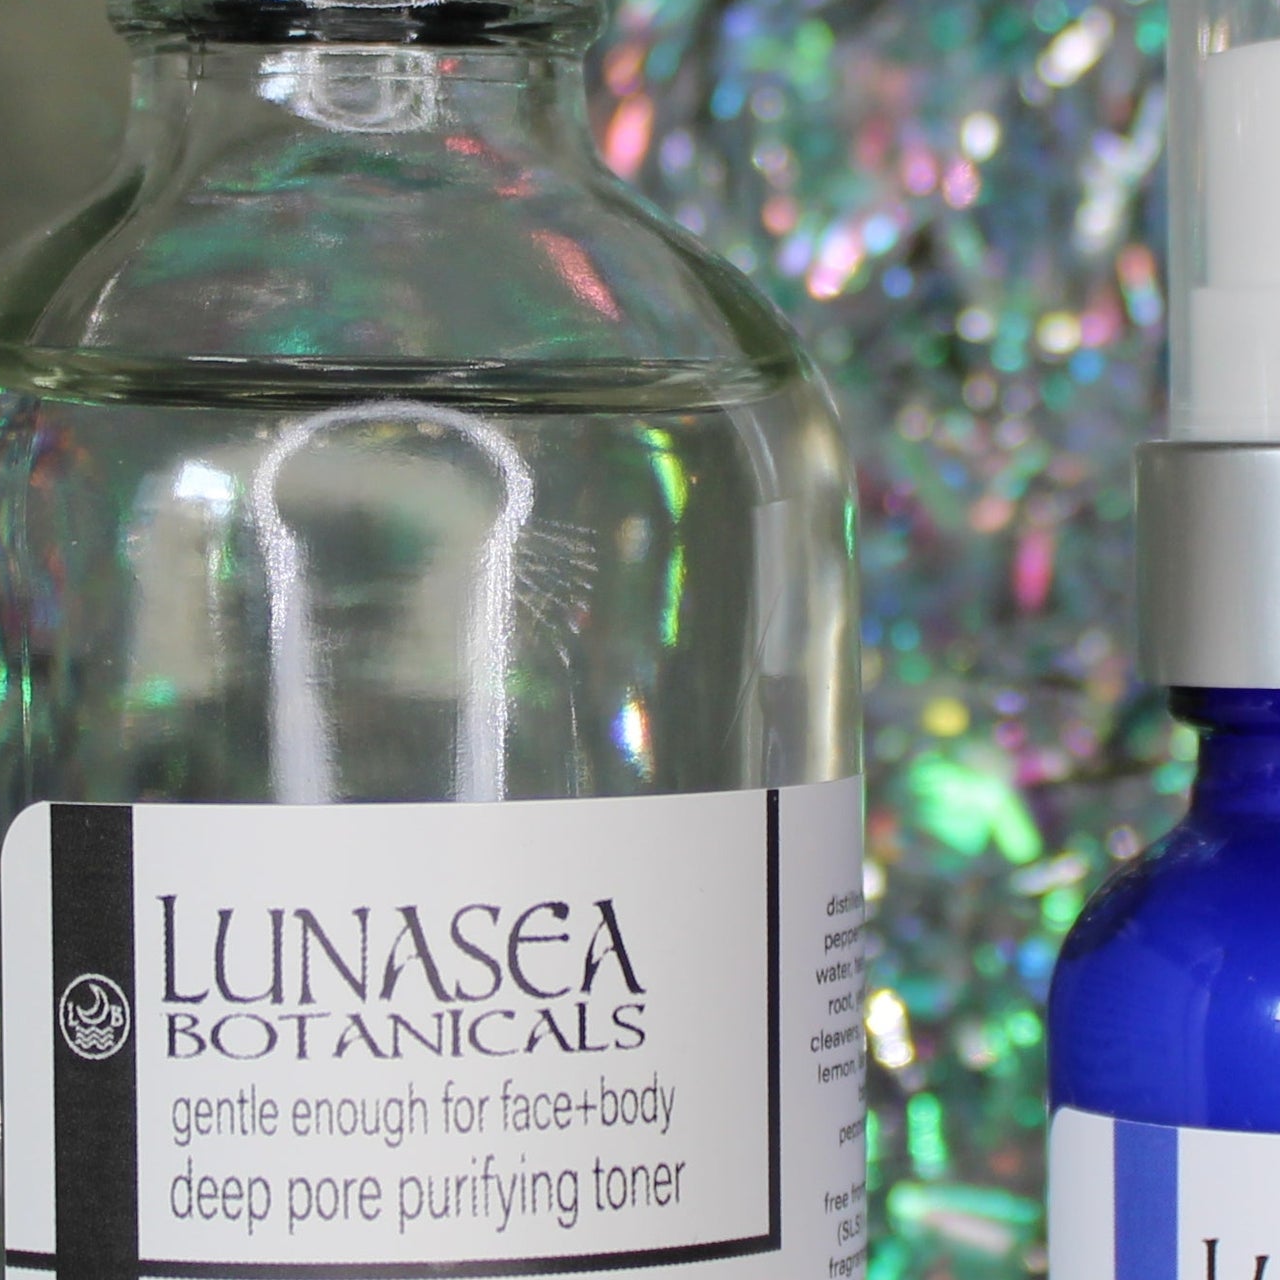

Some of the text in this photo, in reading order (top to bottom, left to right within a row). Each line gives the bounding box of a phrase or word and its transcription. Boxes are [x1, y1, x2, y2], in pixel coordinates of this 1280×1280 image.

[157, 894, 647, 1004] LUNASEA
[165, 1003, 646, 1061] BOTANICALS
[172, 1071, 675, 1149] gentle enough for face+body
[170, 1153, 686, 1236] deep pore purifying toner
[824, 1191, 849, 1214] free
